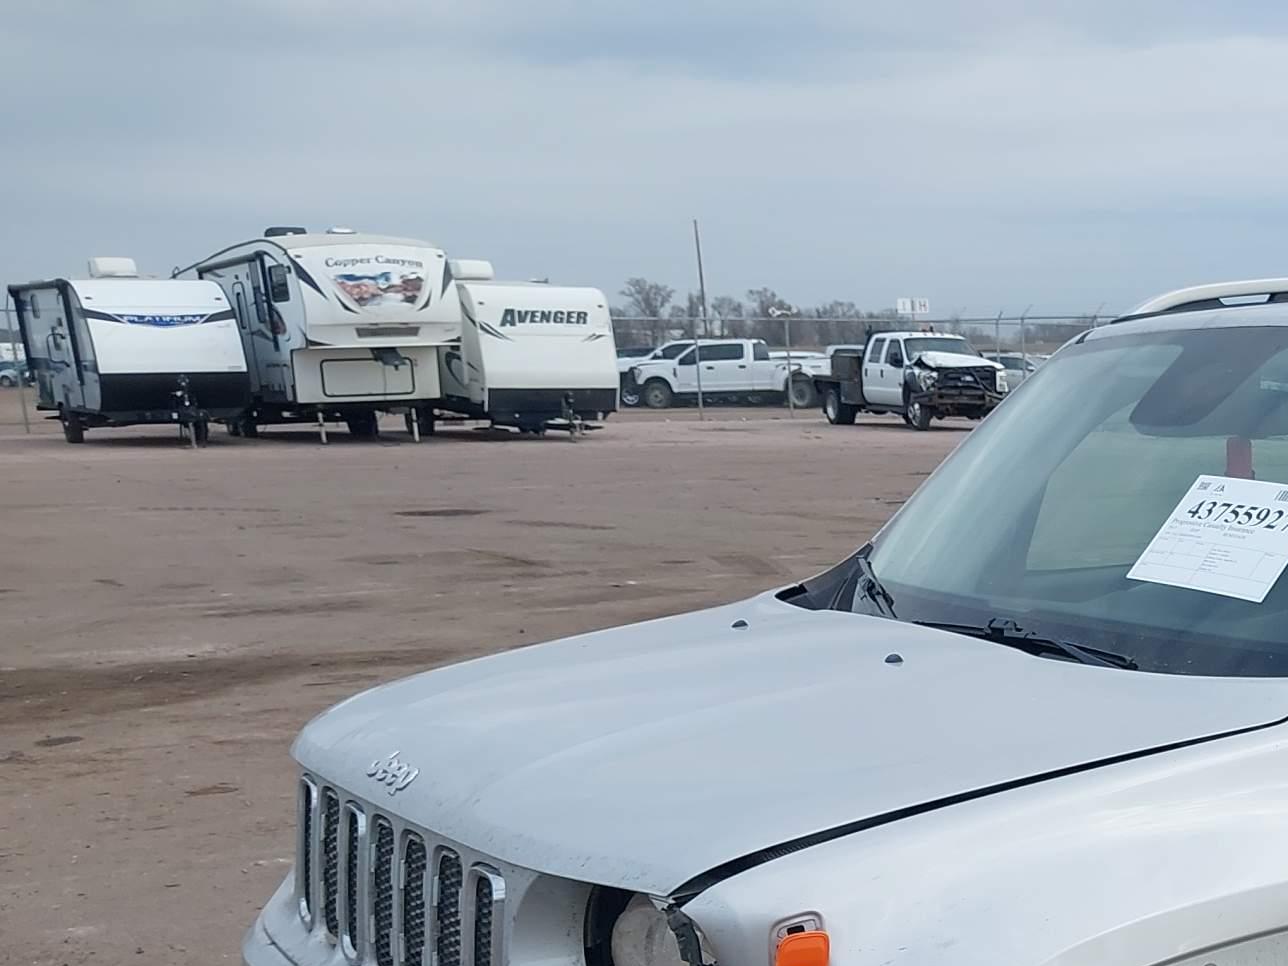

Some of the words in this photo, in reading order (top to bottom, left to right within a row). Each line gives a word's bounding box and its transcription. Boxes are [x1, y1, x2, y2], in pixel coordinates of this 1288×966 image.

[324, 257, 371, 268] Copper
[375, 255, 423, 268] Canyon
[122, 315, 201, 323] PLATINUM
[500, 308, 588, 327] AVENGER
[366, 751, 420, 797] Jeep
